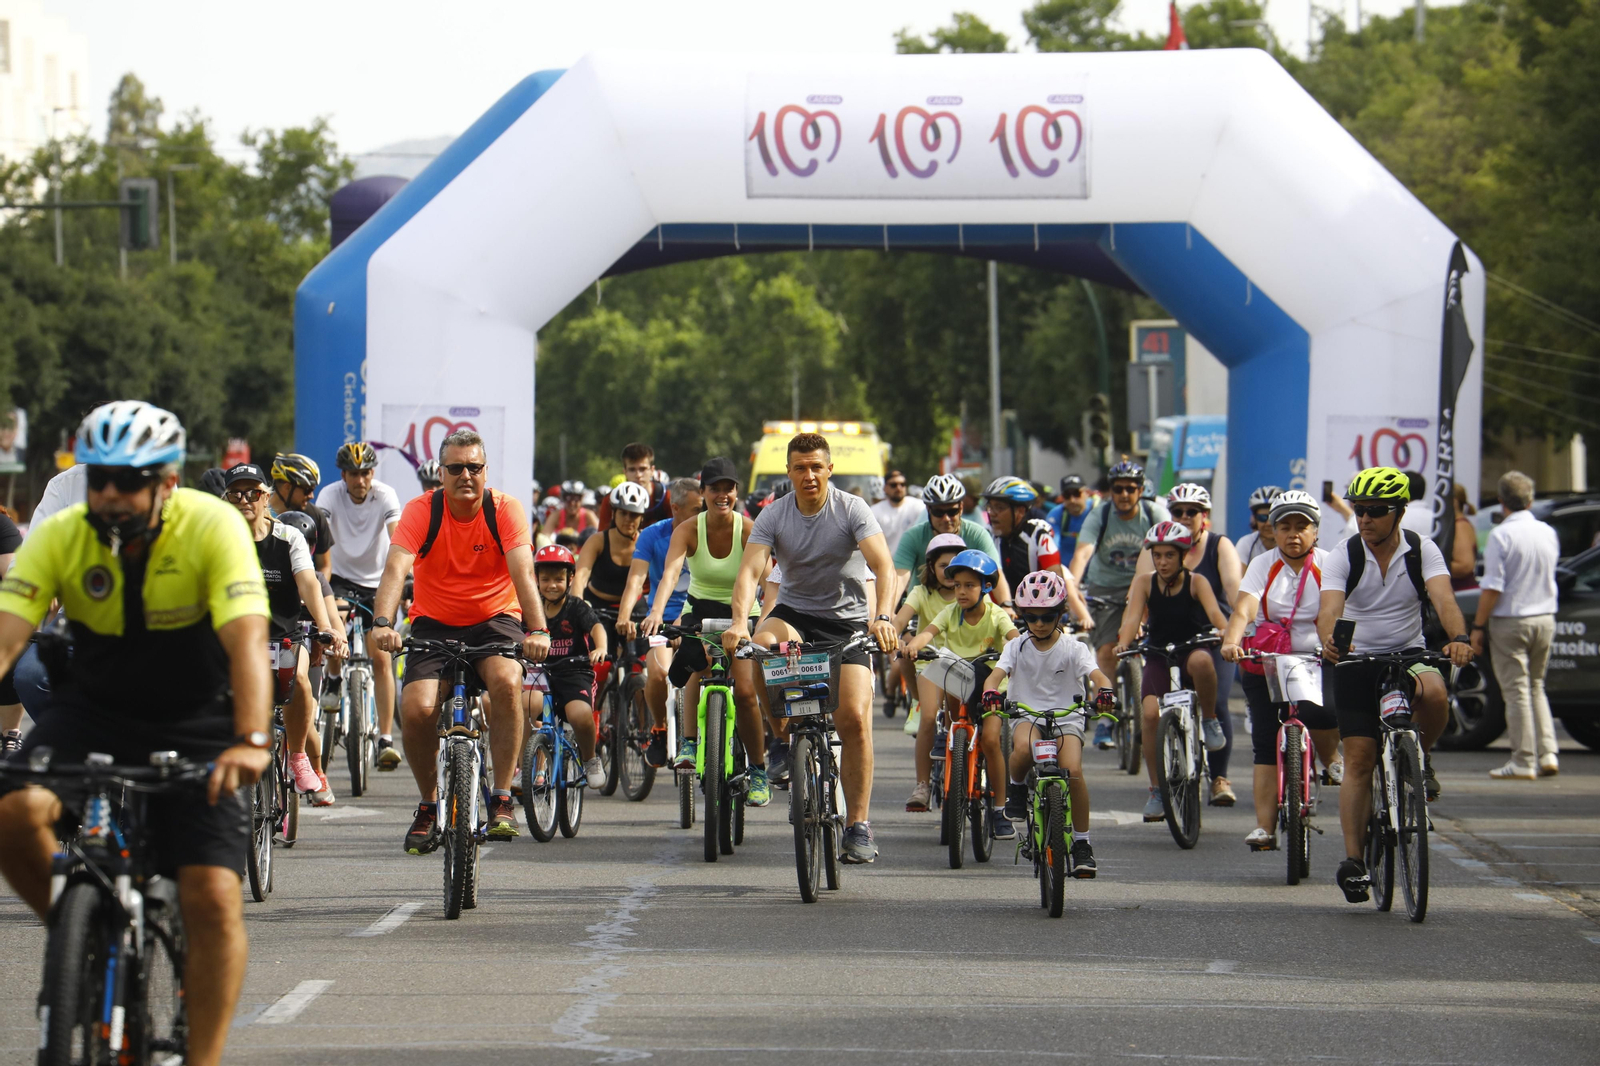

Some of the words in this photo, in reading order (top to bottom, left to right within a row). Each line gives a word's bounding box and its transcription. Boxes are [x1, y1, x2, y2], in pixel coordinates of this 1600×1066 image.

[748, 104, 842, 177] 100
[869, 106, 962, 179] 100
[989, 105, 1082, 178] 100
[343, 371, 357, 444] CiclosCA
[1556, 621, 1587, 636] EVO
[552, 638, 574, 647] rates
[1551, 639, 1598, 656] TROËN
[771, 668, 791, 677] 0061
[801, 664, 823, 673] 00618
